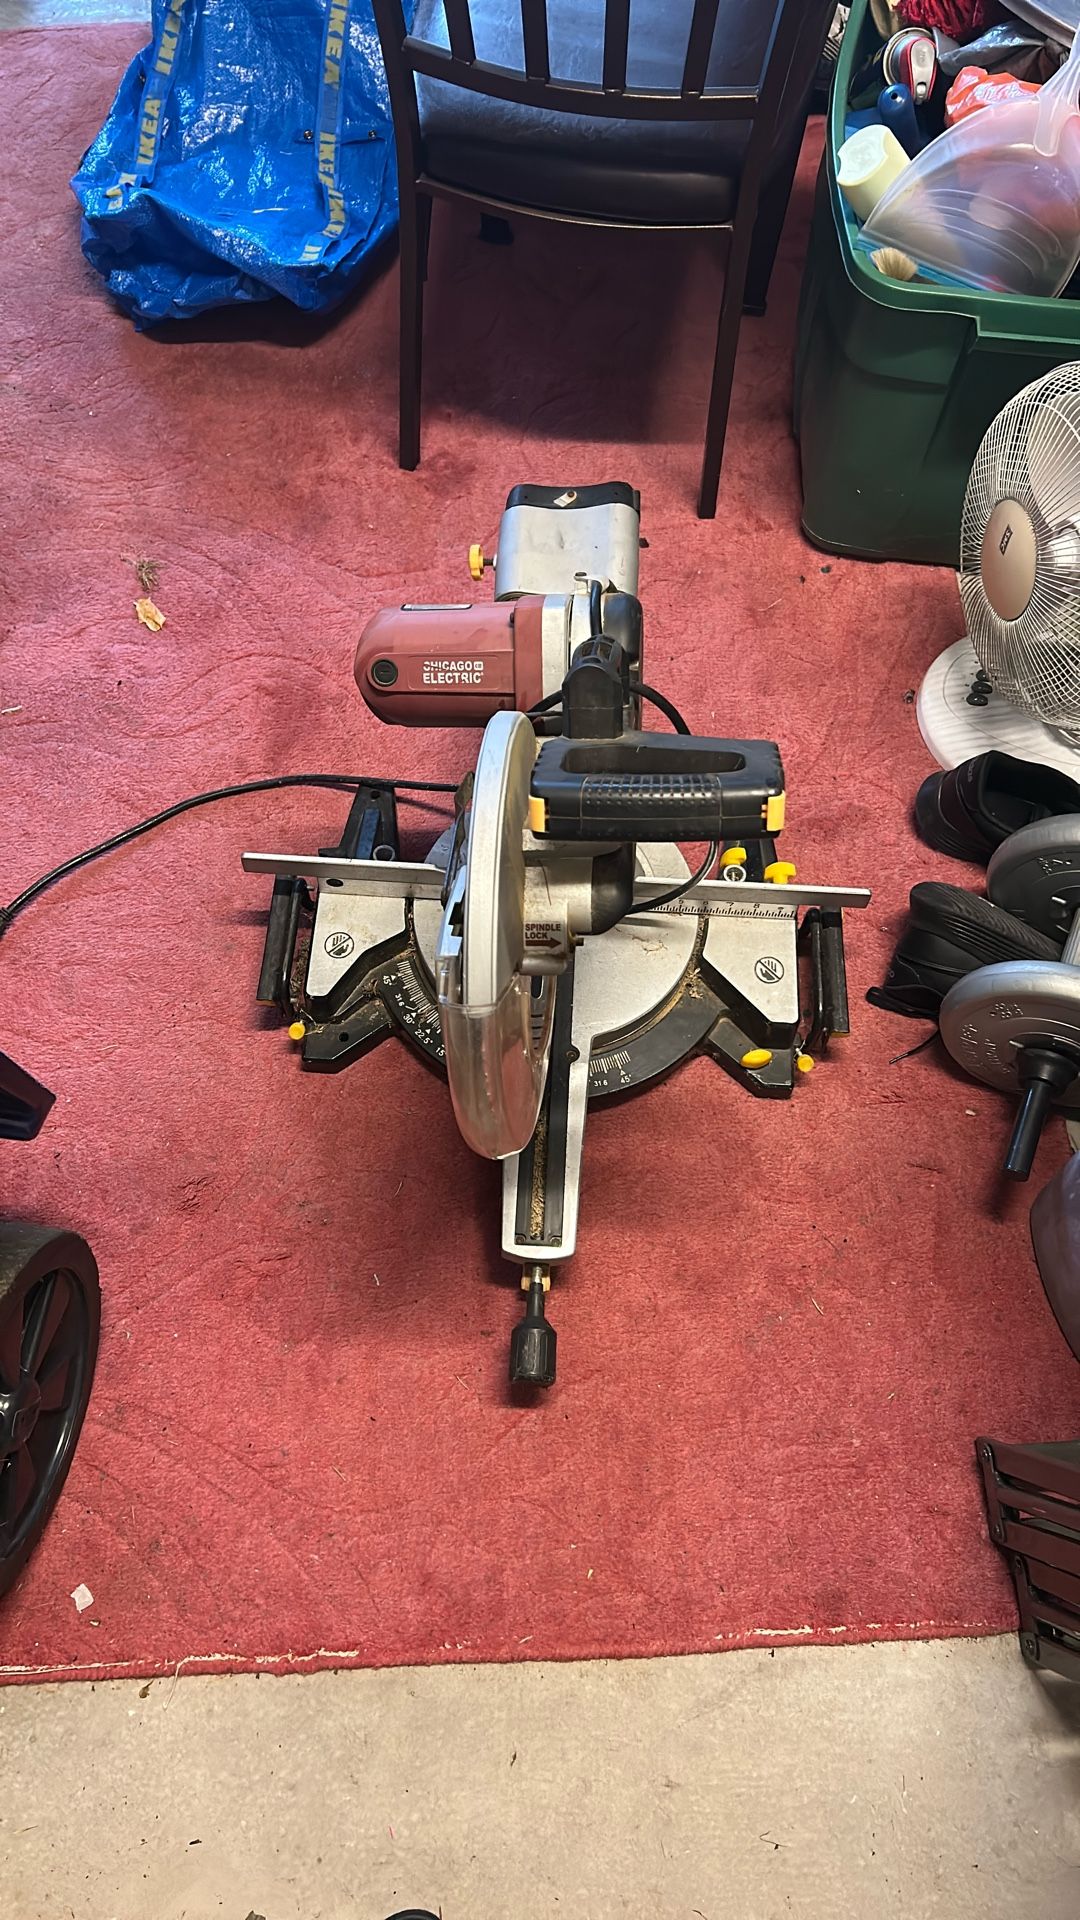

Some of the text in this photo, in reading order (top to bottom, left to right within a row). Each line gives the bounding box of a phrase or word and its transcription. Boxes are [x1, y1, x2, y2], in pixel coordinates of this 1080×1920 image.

[136, 97, 160, 165] IKEA
[423, 661, 472, 671] CHICAGO
[525, 923, 561, 931] SPINDLE
[435, 1046, 447, 1057] 15
